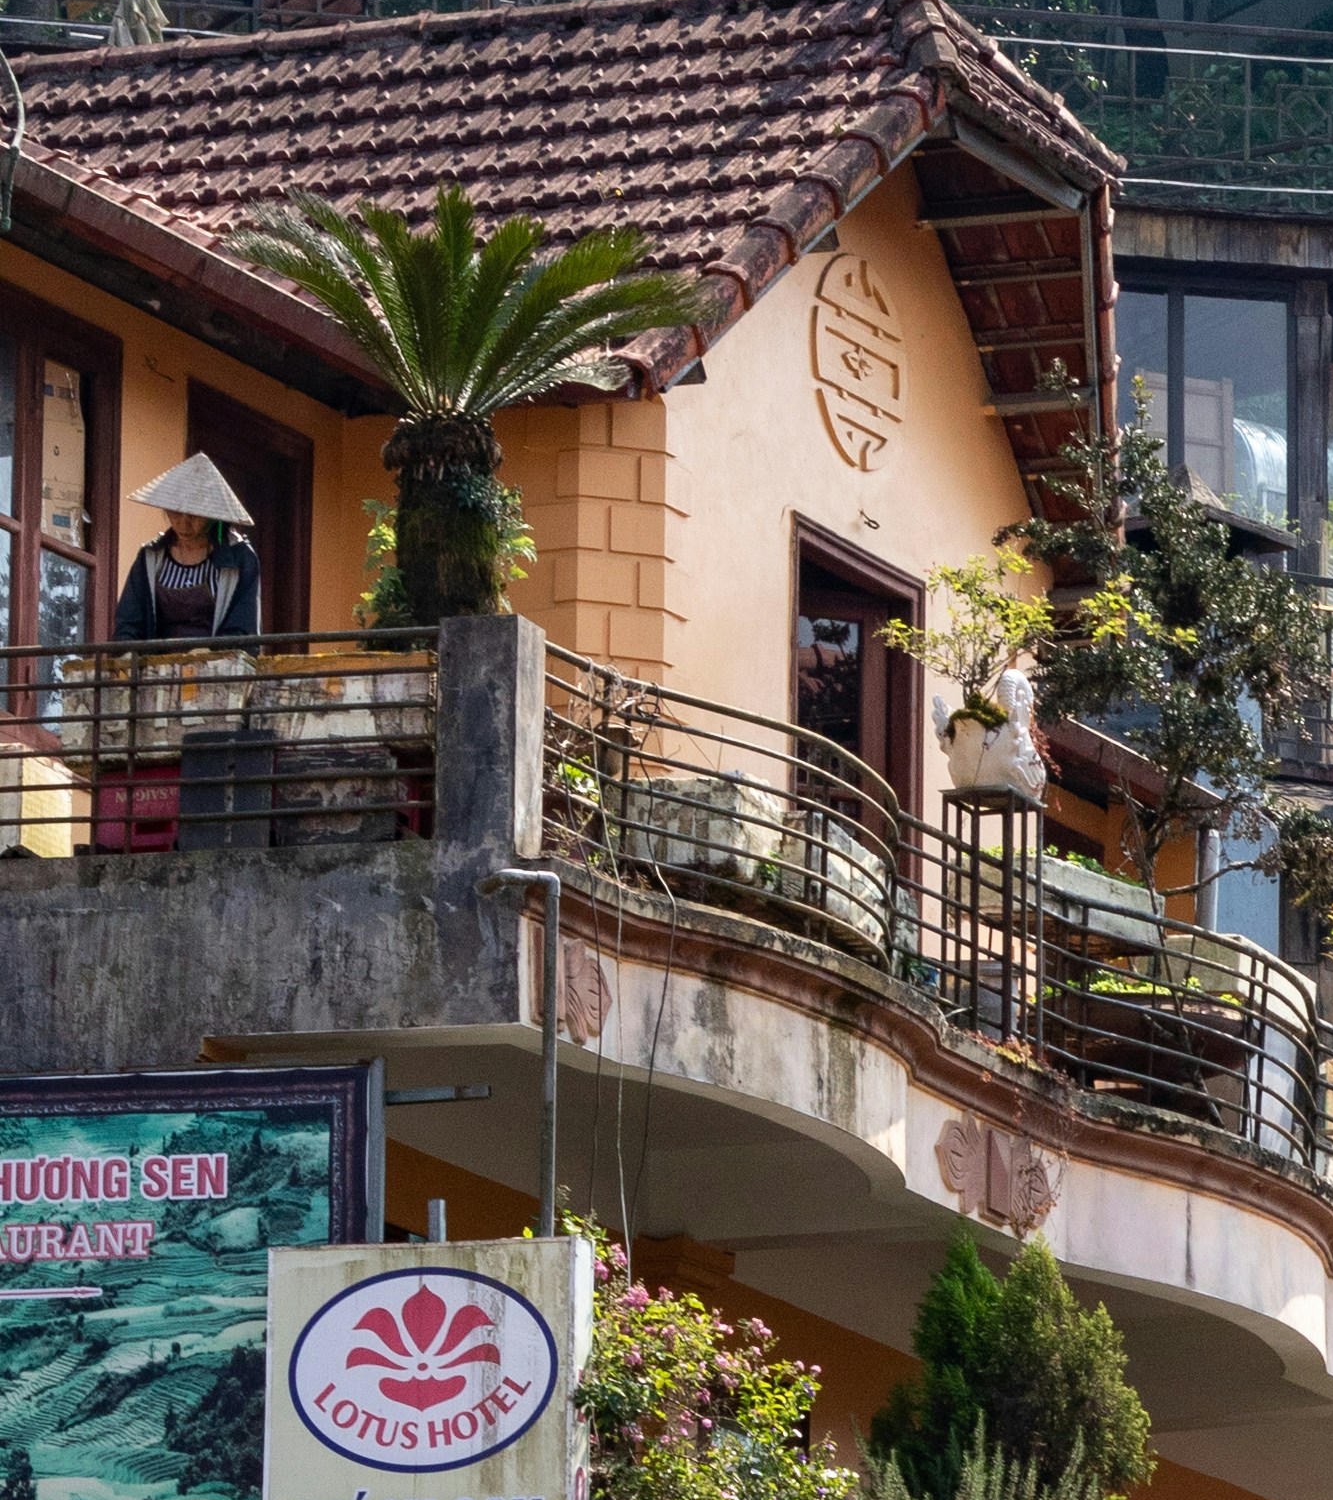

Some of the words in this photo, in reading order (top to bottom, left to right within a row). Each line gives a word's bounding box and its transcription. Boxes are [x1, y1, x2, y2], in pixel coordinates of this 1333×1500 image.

[143, 1154, 226, 1200] SEN
[0, 1222, 154, 1262] URANT
[312, 1382, 418, 1449] LOTUS
[428, 1376, 531, 1449] HOTEL
